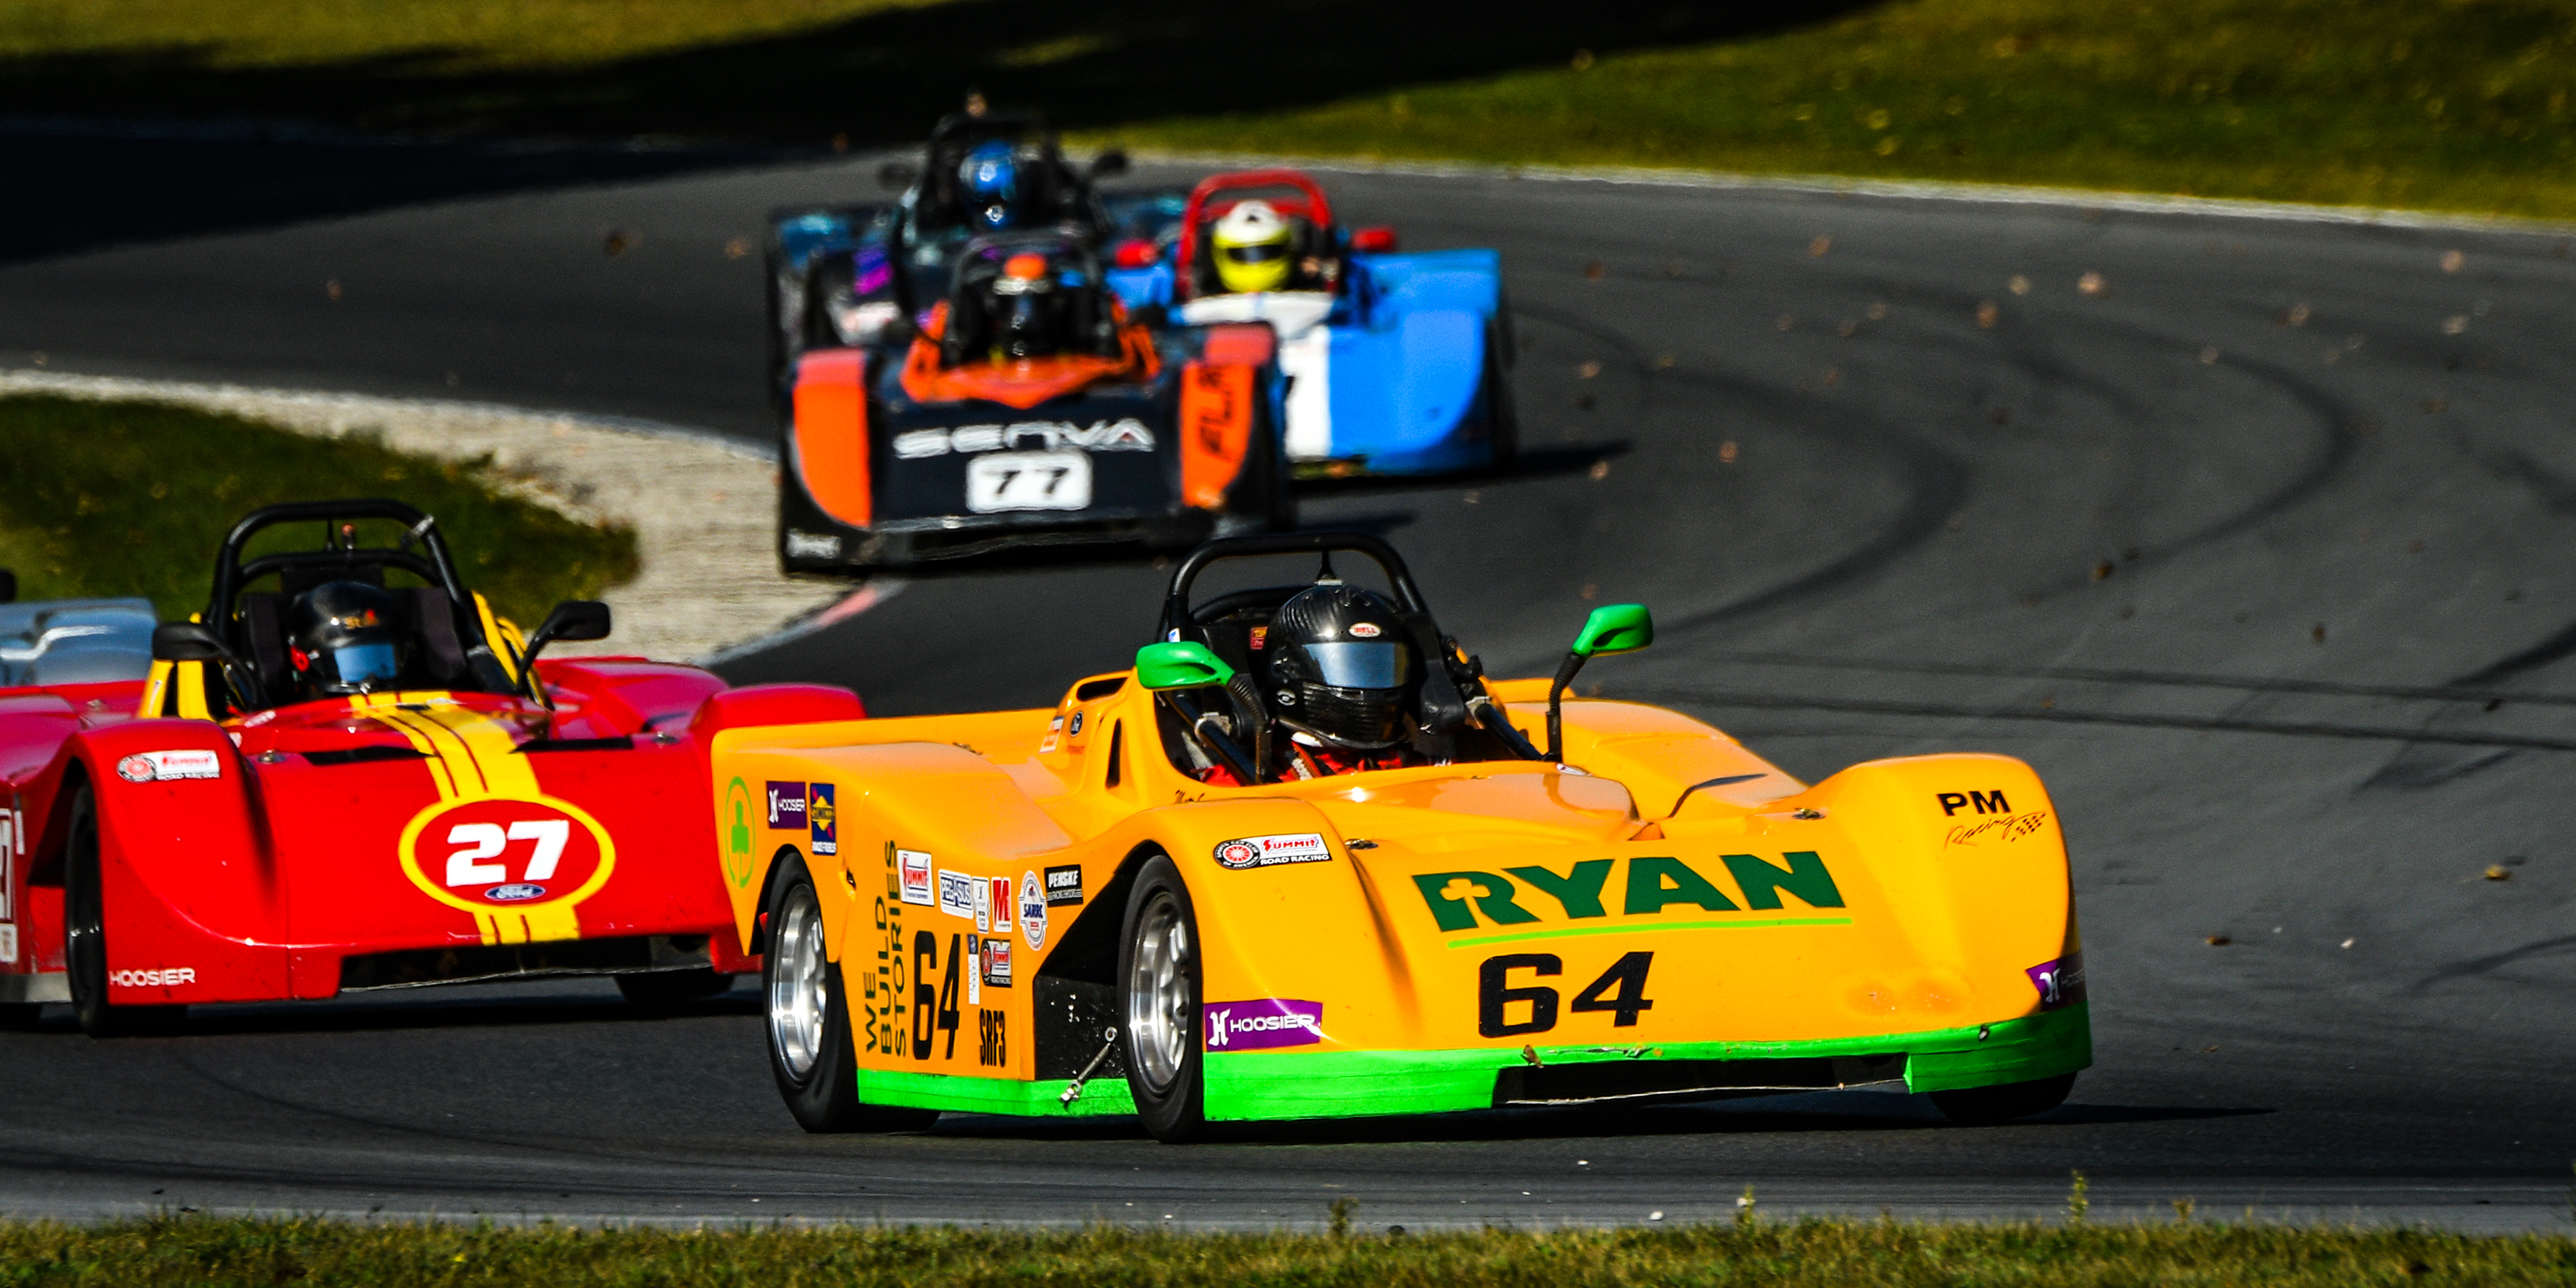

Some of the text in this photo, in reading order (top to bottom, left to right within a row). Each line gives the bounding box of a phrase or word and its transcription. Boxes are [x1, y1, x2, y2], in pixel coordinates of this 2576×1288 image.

[982, 467, 1071, 496] 77
[778, 798, 806, 812] HOOSIER
[1936, 790, 2013, 817] PM
[446, 819, 570, 886] 27
[1048, 870, 1078, 888] PENSKE
[1261, 857, 1289, 865] ROAD
[1411, 851, 1846, 932] RYAN
[108, 967, 196, 987] HOOSIER
[875, 895, 892, 1055] BUILD
[885, 840, 907, 1058] STORIES
[863, 970, 878, 1053] WE
[913, 930, 961, 1061] 64
[1229, 1014, 1316, 1033] HOOSIER
[1478, 951, 1654, 1038] 64
[979, 1008, 1006, 1068] SRF3
